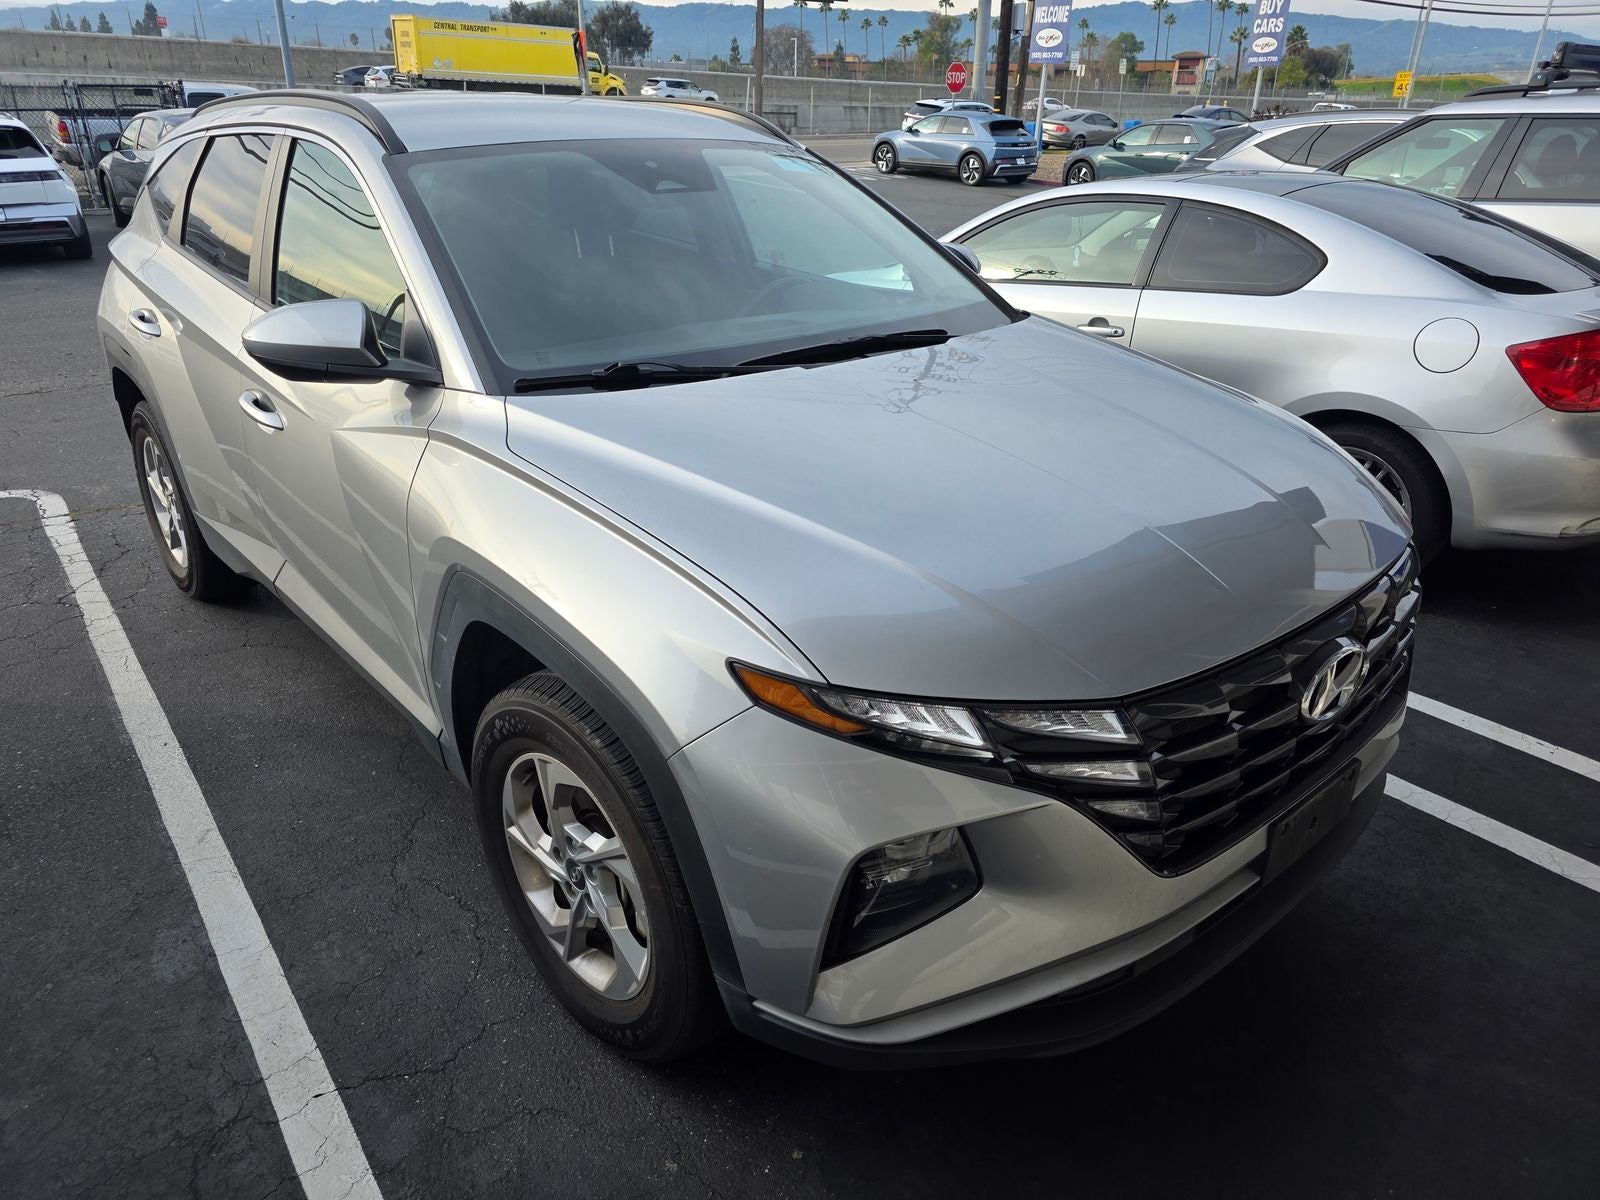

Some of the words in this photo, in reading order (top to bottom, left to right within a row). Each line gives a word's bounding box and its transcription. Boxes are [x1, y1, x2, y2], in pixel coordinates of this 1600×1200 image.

[1035, 5, 1070, 24] WELCOME
[1259, 0, 1284, 15] BUY
[433, 21, 457, 31] CENTRAL
[460, 23, 490, 33] TRANSPORT
[1253, 17, 1284, 34] CARS
[947, 72, 966, 84] STOP
